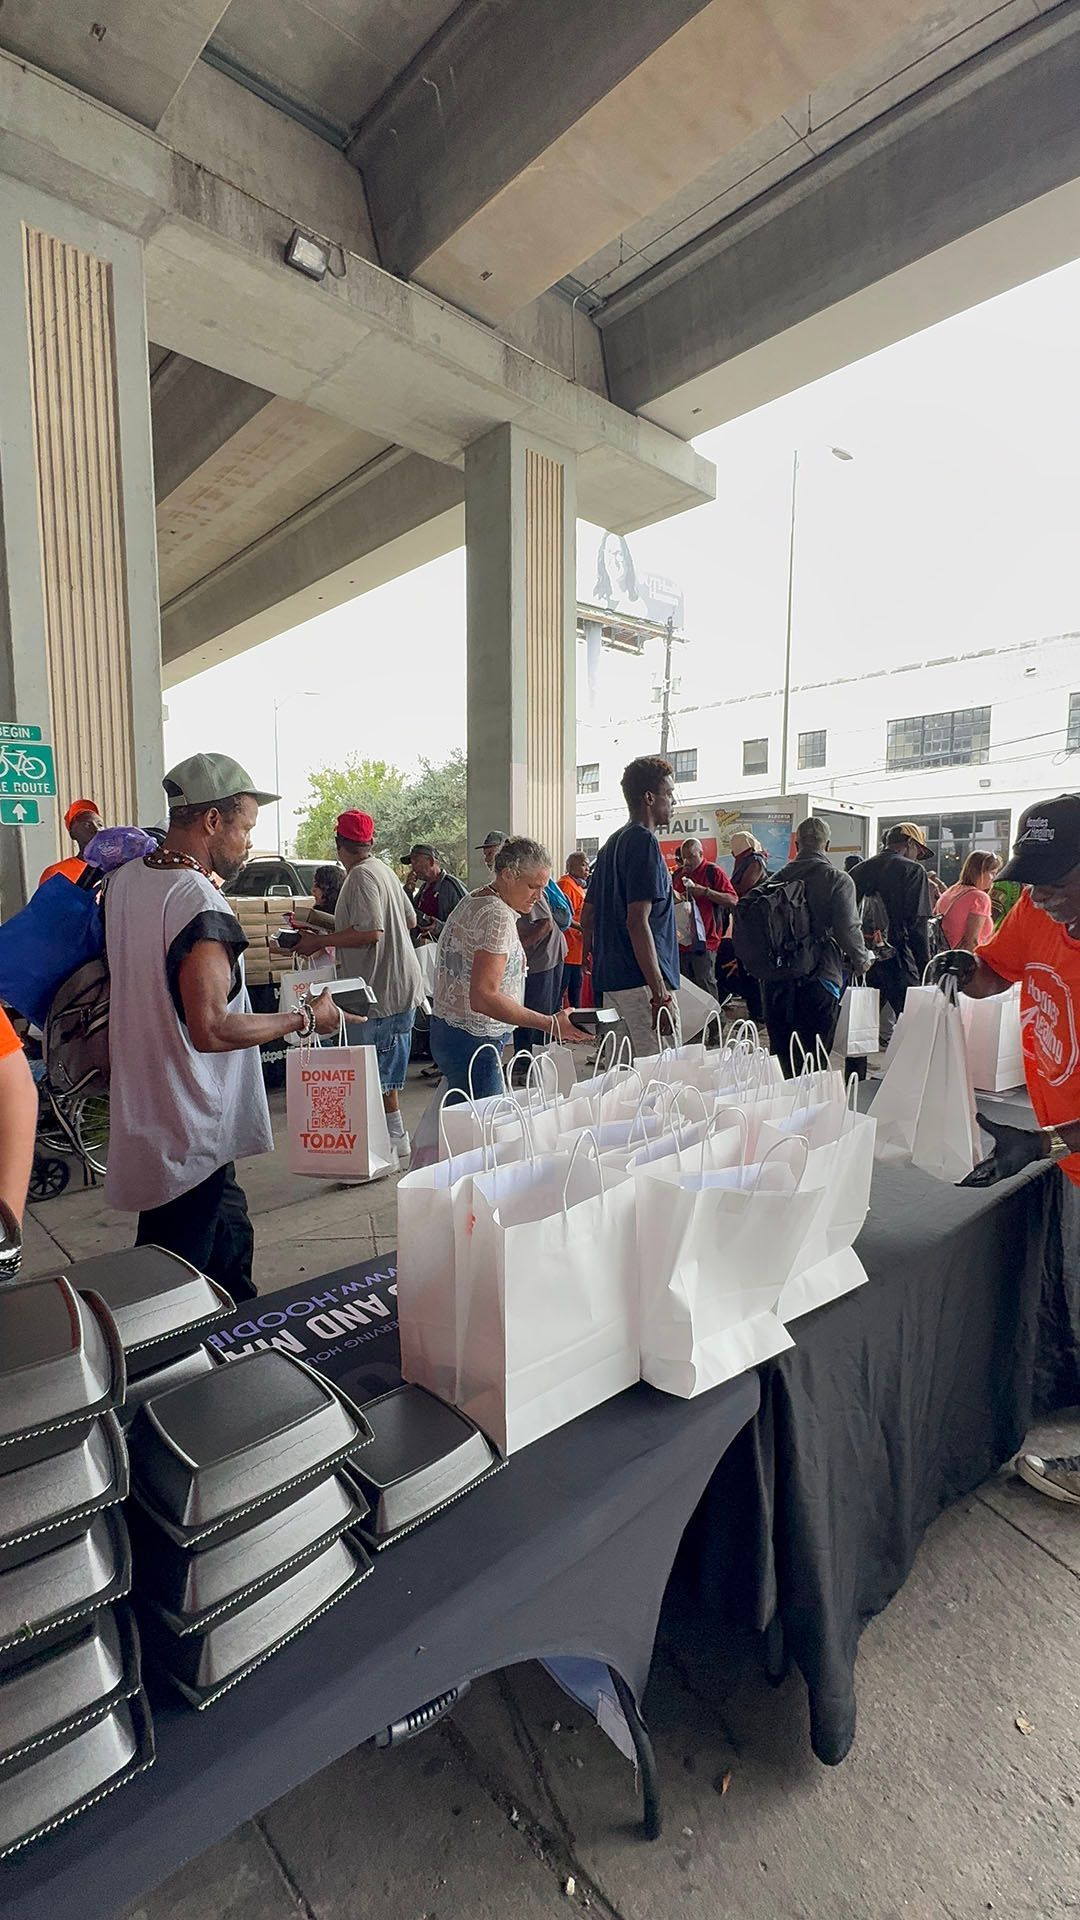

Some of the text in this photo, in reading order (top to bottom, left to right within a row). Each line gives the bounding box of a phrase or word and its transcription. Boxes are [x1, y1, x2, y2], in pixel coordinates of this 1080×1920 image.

[13, 782, 50, 793] ROUTE
[301, 1070, 355, 1081] DONATE
[300, 1134, 357, 1149] TODAY
[306, 1293, 391, 1340] AND
[343, 1319, 399, 1348] ERVING
